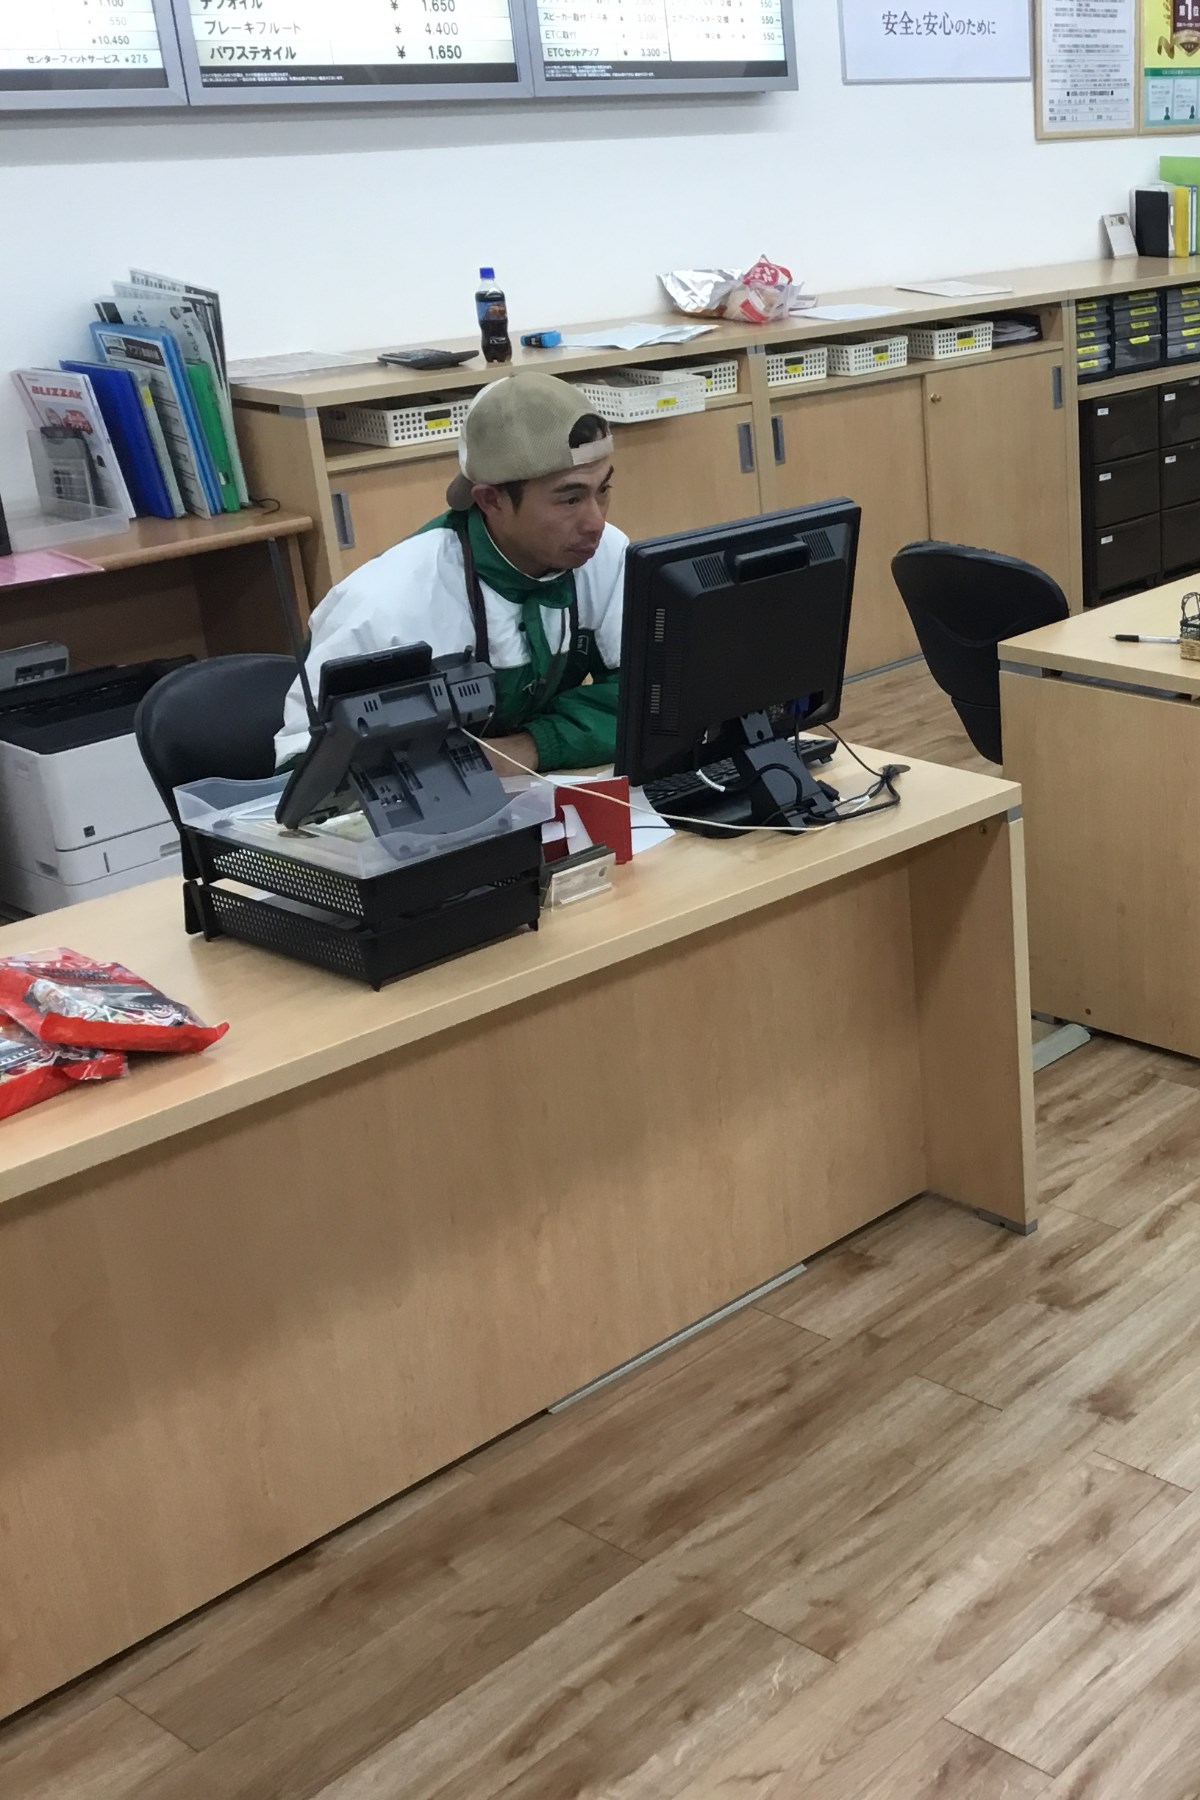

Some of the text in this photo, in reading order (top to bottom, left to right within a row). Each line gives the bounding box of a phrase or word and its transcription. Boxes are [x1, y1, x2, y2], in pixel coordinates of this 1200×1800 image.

[882, 10, 997, 36] 安全と安心のために
[26, 54, 120, 64] センターフィットサービス
[210, 45, 462, 61] パワステオイル ¥ 1,650
[547, 48, 600, 57] ETCセットアップ
[31, 385, 83, 400] BLIZZAK
